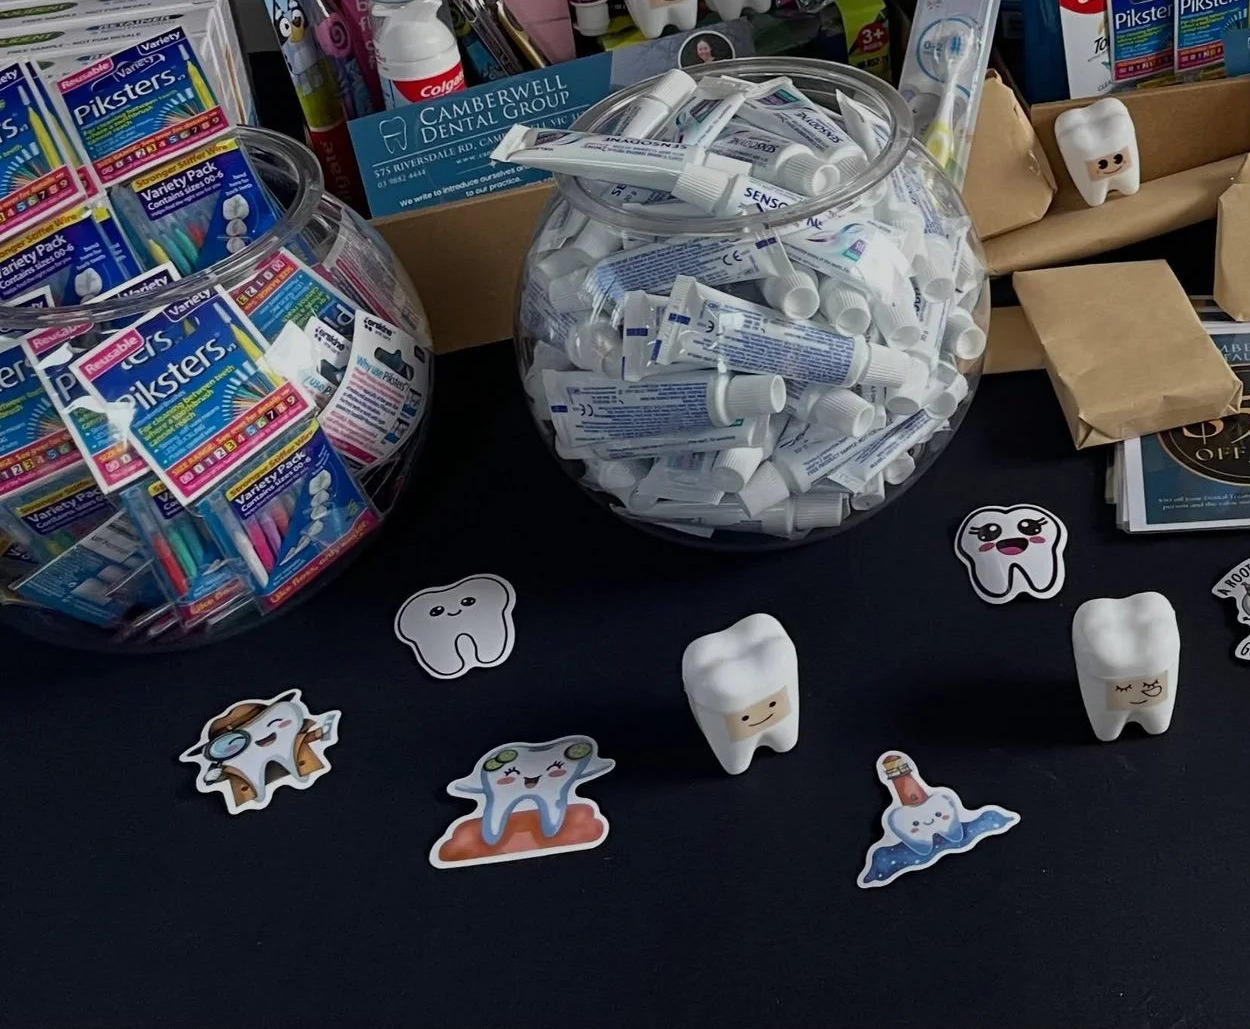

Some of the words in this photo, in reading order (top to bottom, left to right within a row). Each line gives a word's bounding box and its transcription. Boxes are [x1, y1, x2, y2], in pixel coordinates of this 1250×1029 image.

[141, 30, 181, 51] Variety
[861, 28, 884, 44] 3+
[60, 61, 110, 90] Reusable
[420, 71, 464, 99] Colga
[73, 68, 177, 126] Piksters
[419, 74, 568, 126] CAMBERWELL
[421, 113, 501, 144] DENTAL
[502, 91, 570, 120] GROUP
[602, 136, 688, 150] SENSODYNE
[374, 165, 392, 178] 575
[392, 147, 457, 173] RIVERSDALE
[140, 175, 187, 203] Variety
[187, 160, 218, 183] Pack
[147, 188, 184, 211] Contains
[184, 180, 204, 196] sizes
[203, 170, 225, 186] 00-6
[399, 197, 414, 208] We
[414, 191, 433, 204] write
[433, 189, 442, 197] to
[442, 178, 479, 195] introduce
[479, 168, 516, 185] ourselves
[465, 189, 474, 197] to
[475, 187, 488, 195] our
[488, 175, 523, 193] practice.
[36, 233, 68, 257] Pack
[168, 287, 211, 316] Variety
[84, 336, 138, 373] Reusable
[1195, 445, 1247, 462] OFF
[235, 475, 278, 506] Variety
[277, 449, 307, 475] Pack
[1217, 588, 1231, 596] A
